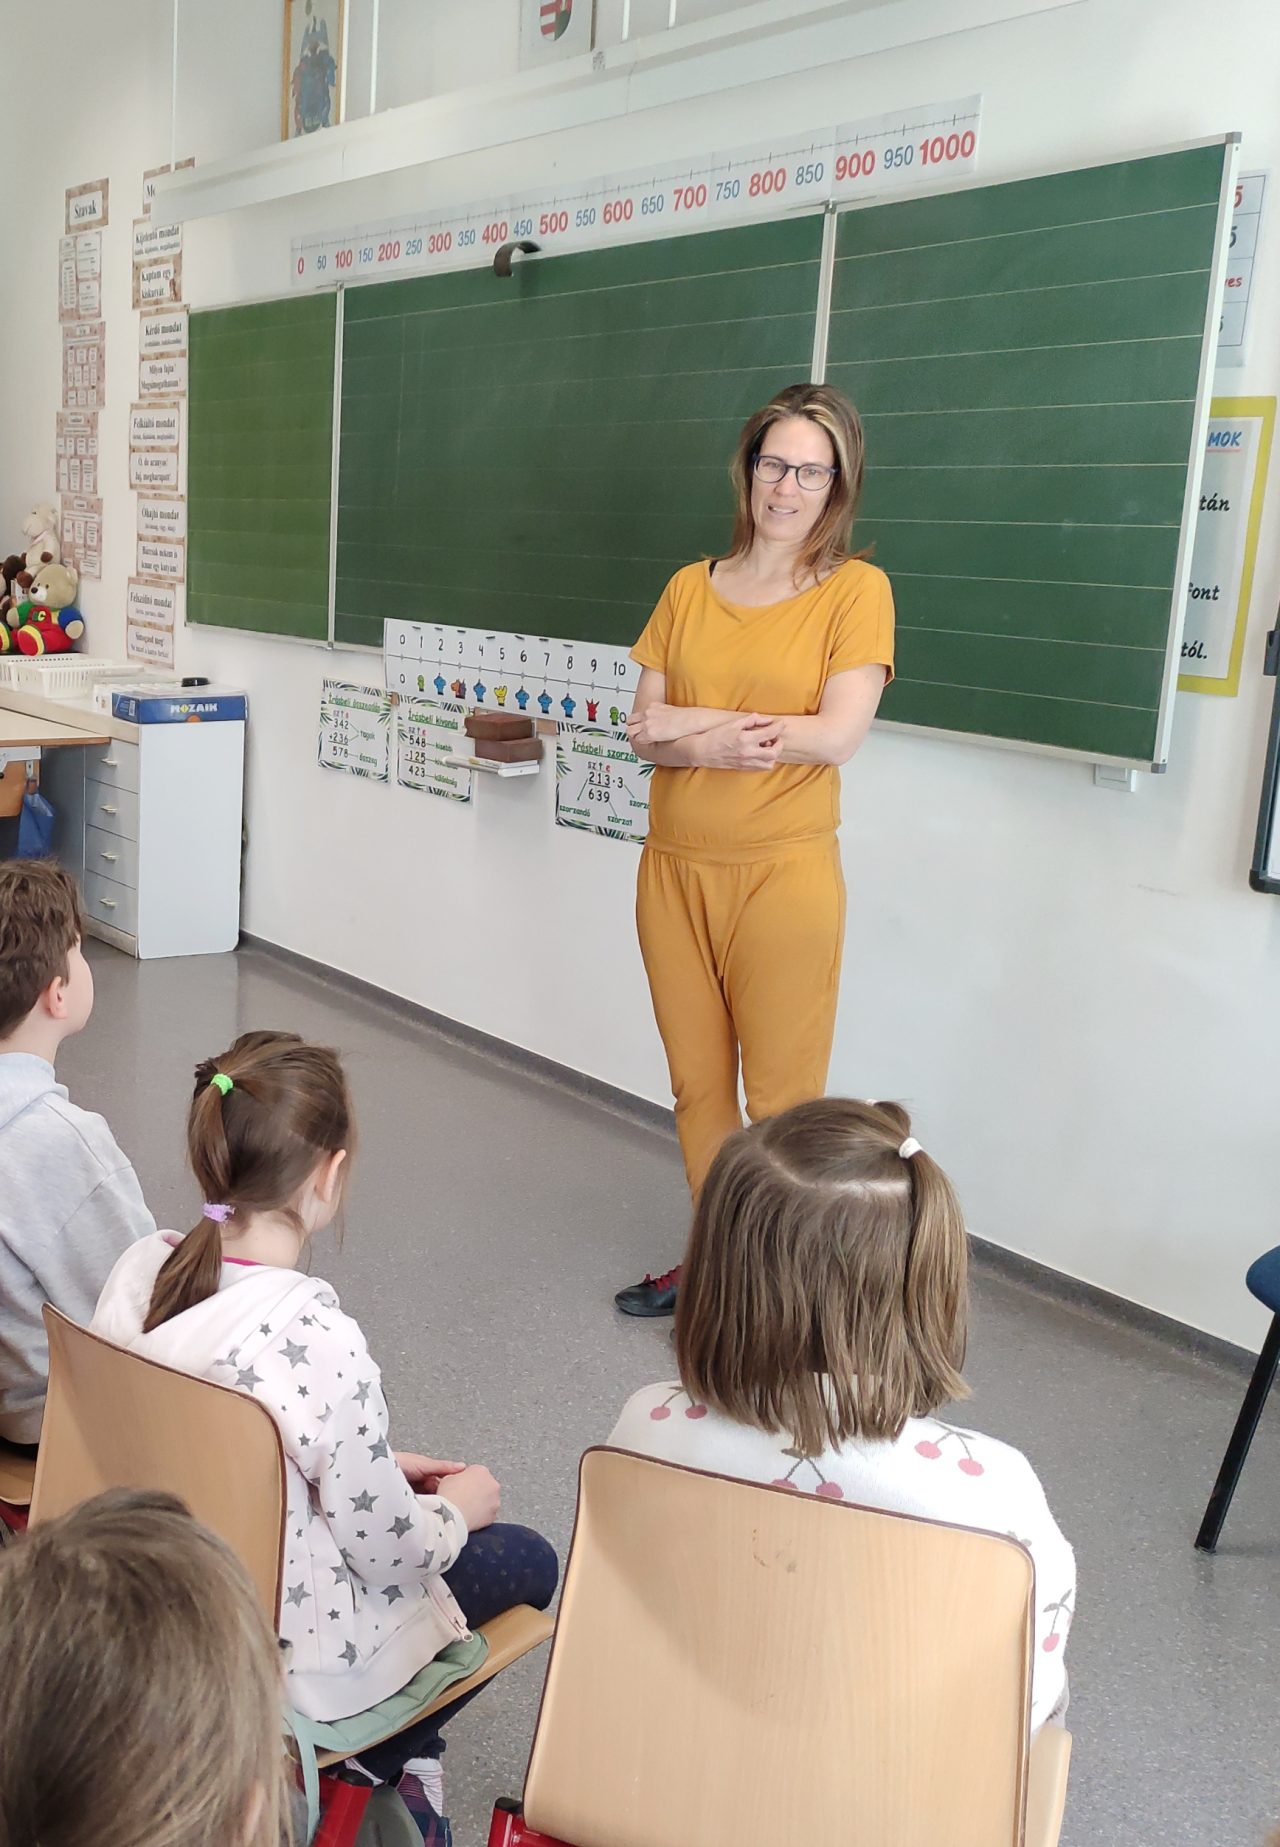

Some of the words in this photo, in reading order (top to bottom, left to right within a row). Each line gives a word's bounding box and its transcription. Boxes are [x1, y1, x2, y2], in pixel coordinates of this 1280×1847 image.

[74, 200, 97, 219] Szavak
[297, 257, 304, 275] 0
[317, 255, 327, 270] 50
[335, 249, 353, 269] 100
[358, 248, 374, 264] 150
[378, 241, 401, 262] 200
[405, 239, 423, 256] 250
[428, 232, 452, 254] 300
[458, 229, 476, 247] 350
[482, 221, 508, 244] 400
[513, 218, 533, 237] 450
[539, 211, 569, 235] 500
[575, 207, 596, 227] 550
[603, 199, 634, 225] 600
[641, 194, 664, 215] 650
[673, 184, 707, 211] 700
[715, 179, 740, 201] 750
[748, 168, 786, 197] 800
[795, 163, 824, 186] 850
[835, 150, 876, 181] 900
[883, 145, 914, 169] 950
[919, 130, 976, 165] 1000
[1207, 430, 1242, 448] MOK
[400, 634, 406, 645] 0
[419, 635, 423, 648] 1
[438, 639, 444, 652] 2
[458, 641, 464, 654] 3
[478, 644, 484, 657] 4
[499, 647, 505, 661] 5
[520, 650, 527, 663] 6
[544, 652, 551, 666] 7
[566, 655, 573, 670] 8
[590, 658, 597, 673] 9
[613, 661, 626, 676] 10
[400, 674, 406, 685] 0
[170, 703, 218, 713] MOZAIK
[334, 718, 350, 730] 342
[408, 708, 434, 726] Írásbeli
[409, 734, 426, 748] 548
[572, 738, 604, 756] Írásbeli
[332, 746, 349, 758] 578
[408, 765, 426, 777] 423
[588, 788, 611, 804] 639
